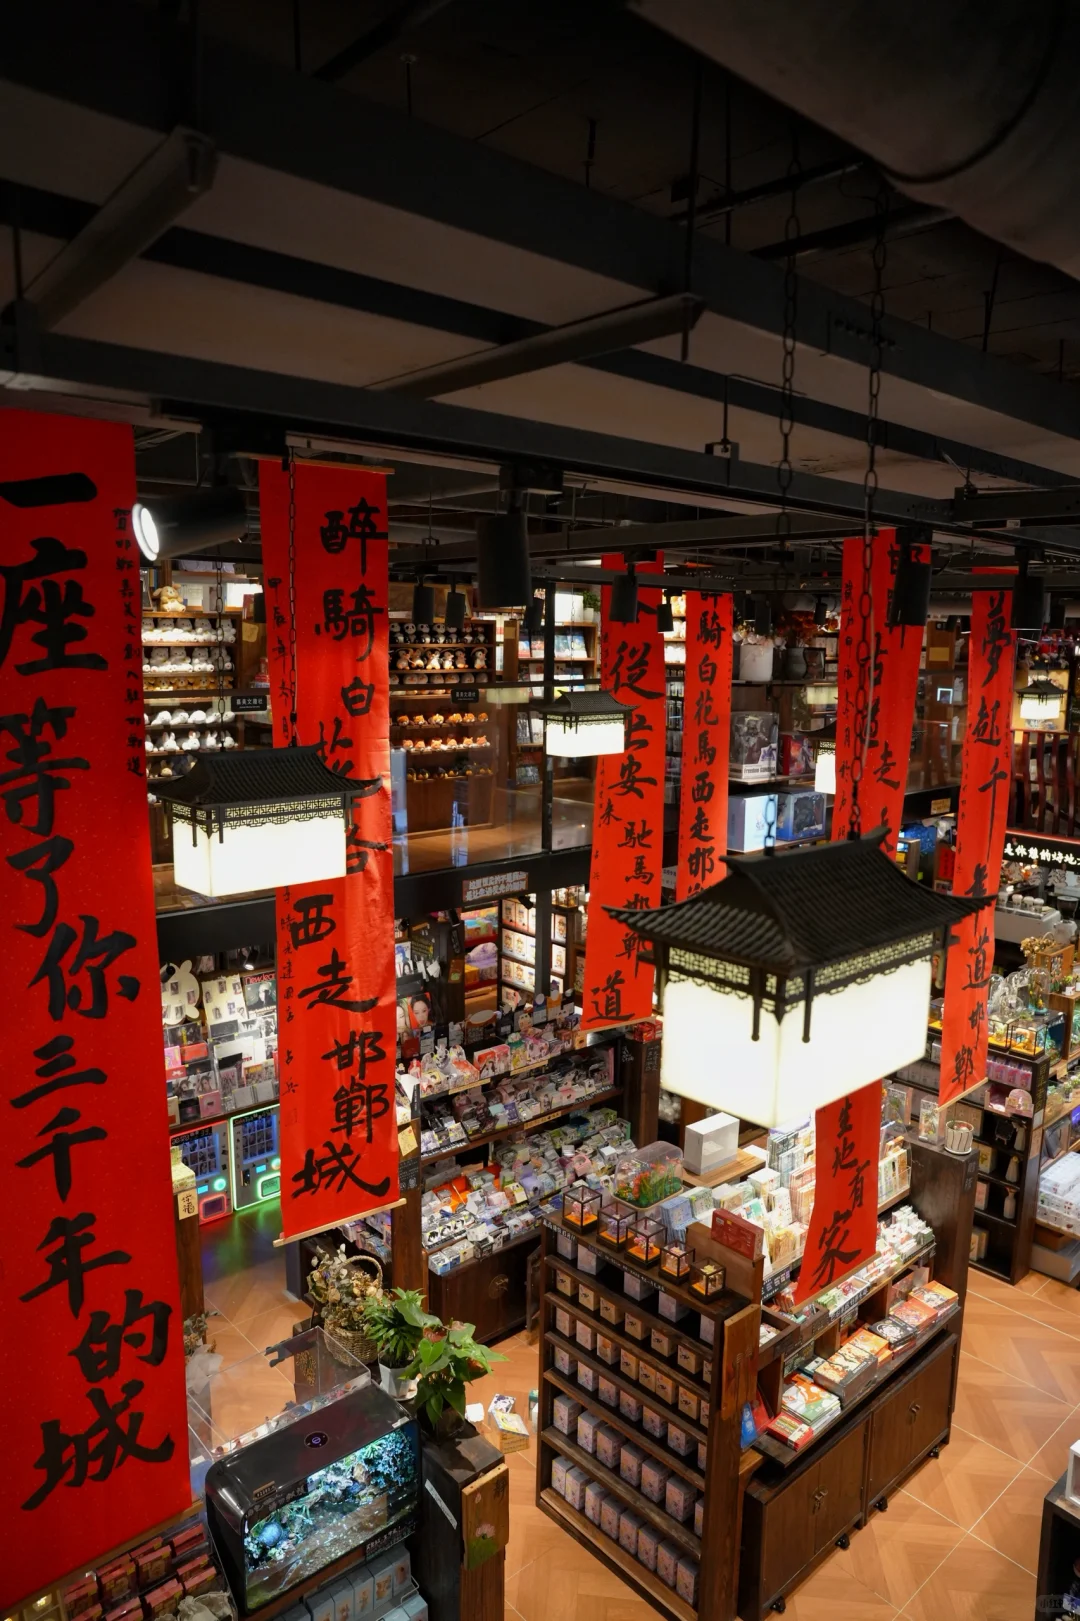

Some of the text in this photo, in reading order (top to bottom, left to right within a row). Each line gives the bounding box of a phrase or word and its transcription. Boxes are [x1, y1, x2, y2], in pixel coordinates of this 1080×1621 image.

[0, 472, 174, 1511] 一座等了你三千年的城
[687, 592, 725, 899] 騎白花馬西走邯
